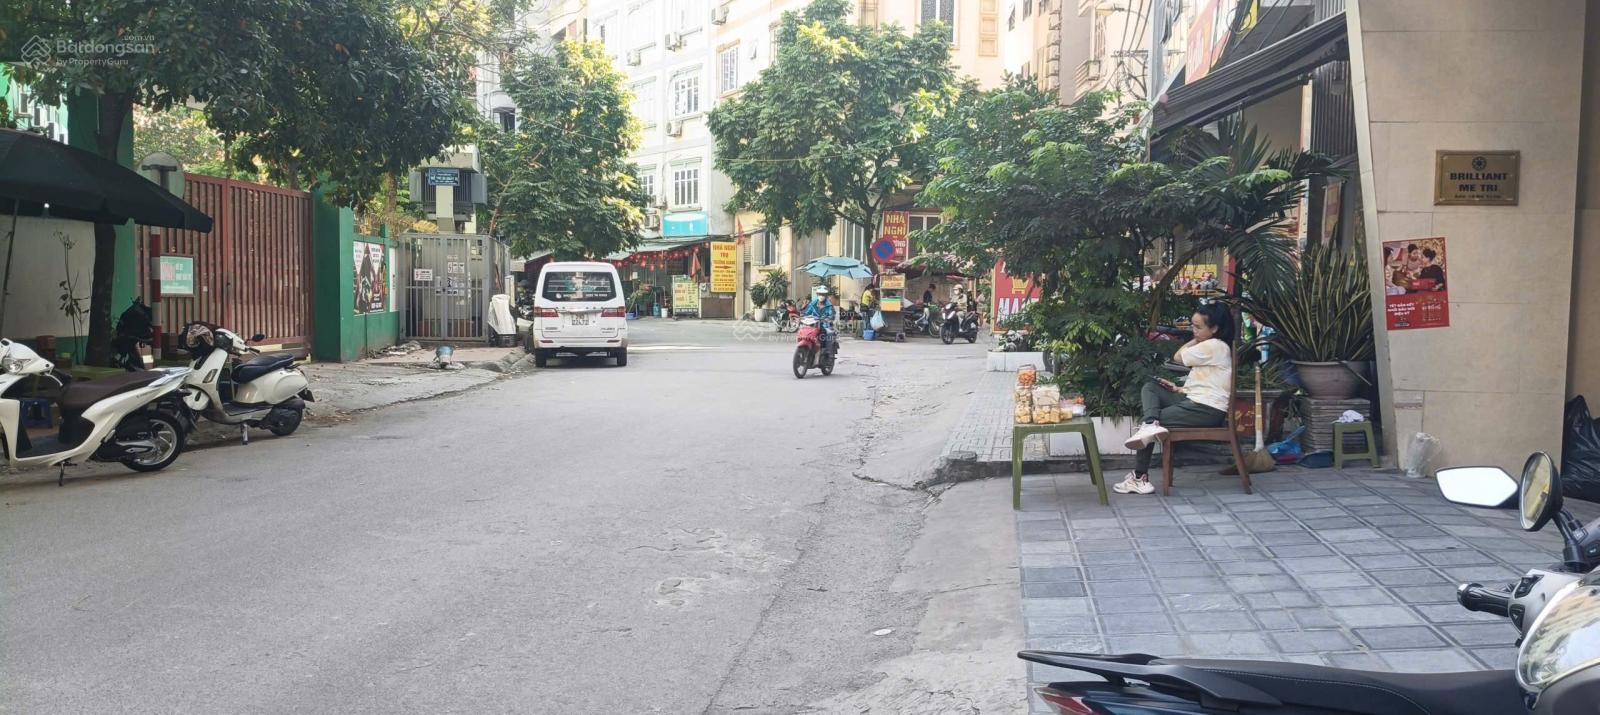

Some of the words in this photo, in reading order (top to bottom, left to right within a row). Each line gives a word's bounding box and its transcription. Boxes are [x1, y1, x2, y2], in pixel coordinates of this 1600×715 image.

[1450, 172, 1508, 181] BRILLIANT
[1459, 184, 1476, 192] ME
[1480, 184, 1498, 192] TRI
[886, 213, 905, 224] NHÀ
[884, 223, 906, 235] NGHỈ
